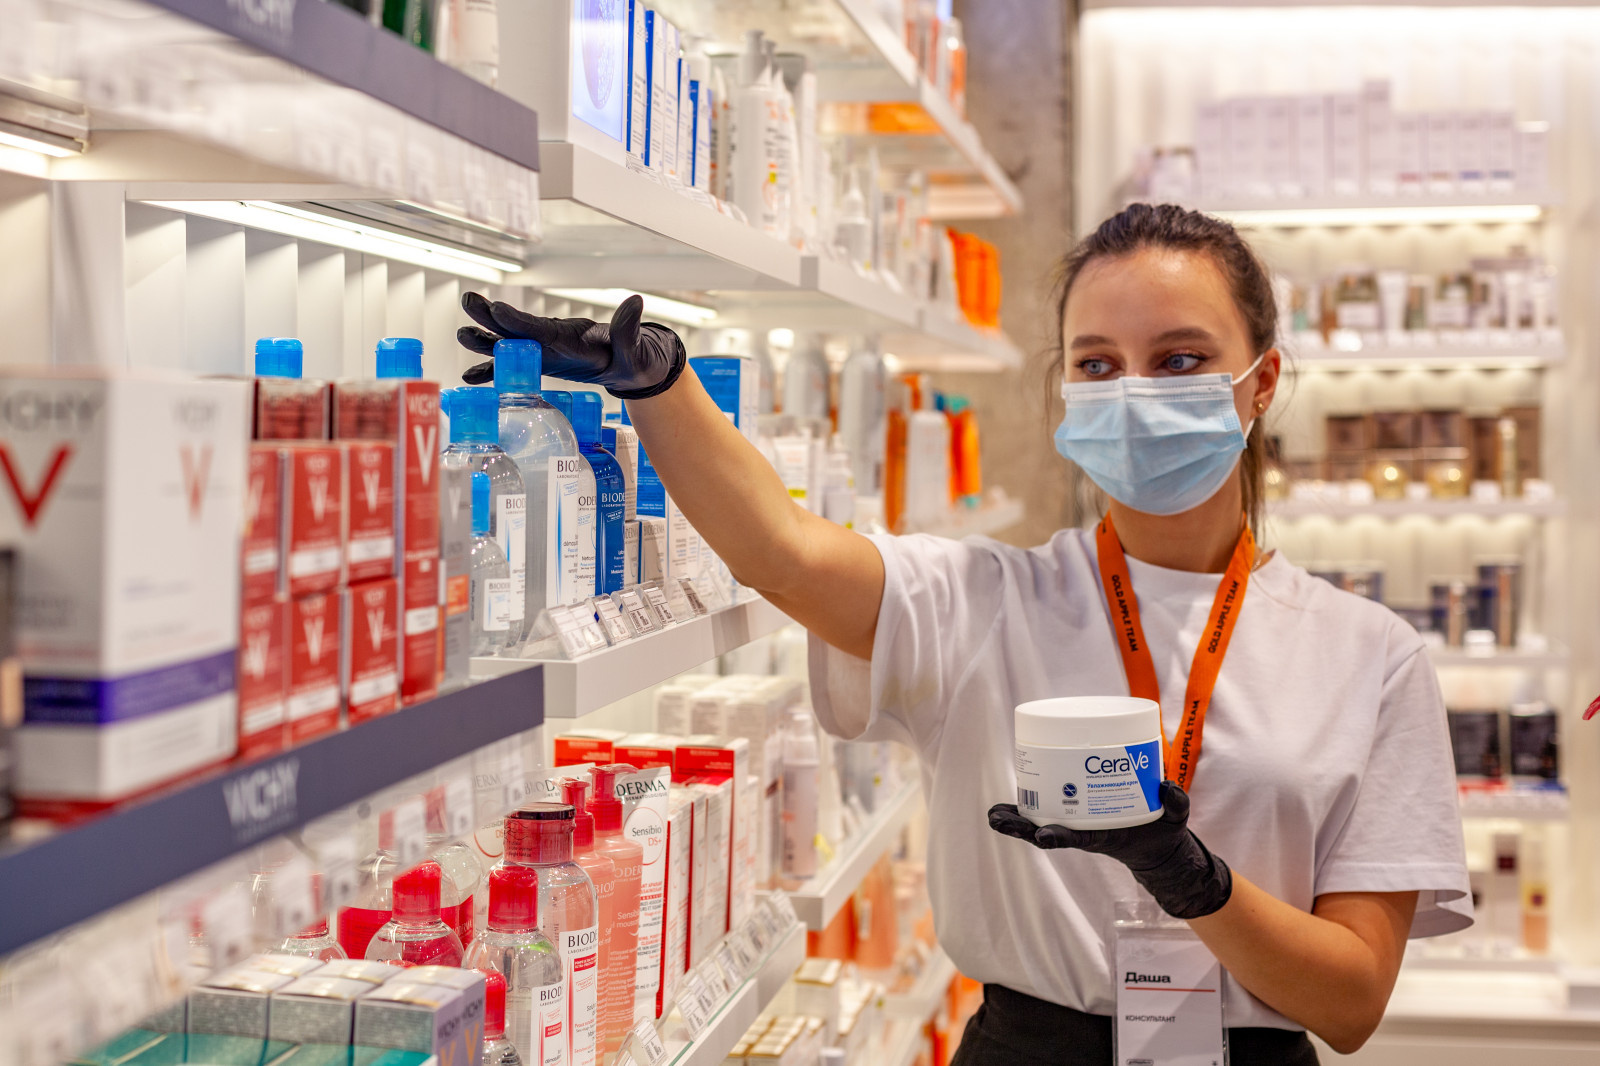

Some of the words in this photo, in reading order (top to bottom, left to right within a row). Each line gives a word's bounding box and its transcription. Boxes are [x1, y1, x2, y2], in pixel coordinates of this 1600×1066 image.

[1112, 574, 1124, 597] GOLD
[1118, 599, 1131, 625] APPLE
[1126, 627, 1139, 652] TEAM
[1207, 631, 1222, 654] GOLD
[1216, 605, 1231, 630] APPLE
[1225, 580, 1240, 603] TEAM
[1181, 729, 1193, 761] APPLE
[1187, 700, 1200, 727] TEAM
[1085, 751, 1149, 774] CeraVe
[615, 779, 667, 797] DERMA
[632, 825, 662, 837] Sensibio
[648, 837, 662, 846] DS+
[1125, 971, 1171, 984] Даша
[1125, 1014, 1176, 1023] КОНСУЛЬТАНТ
